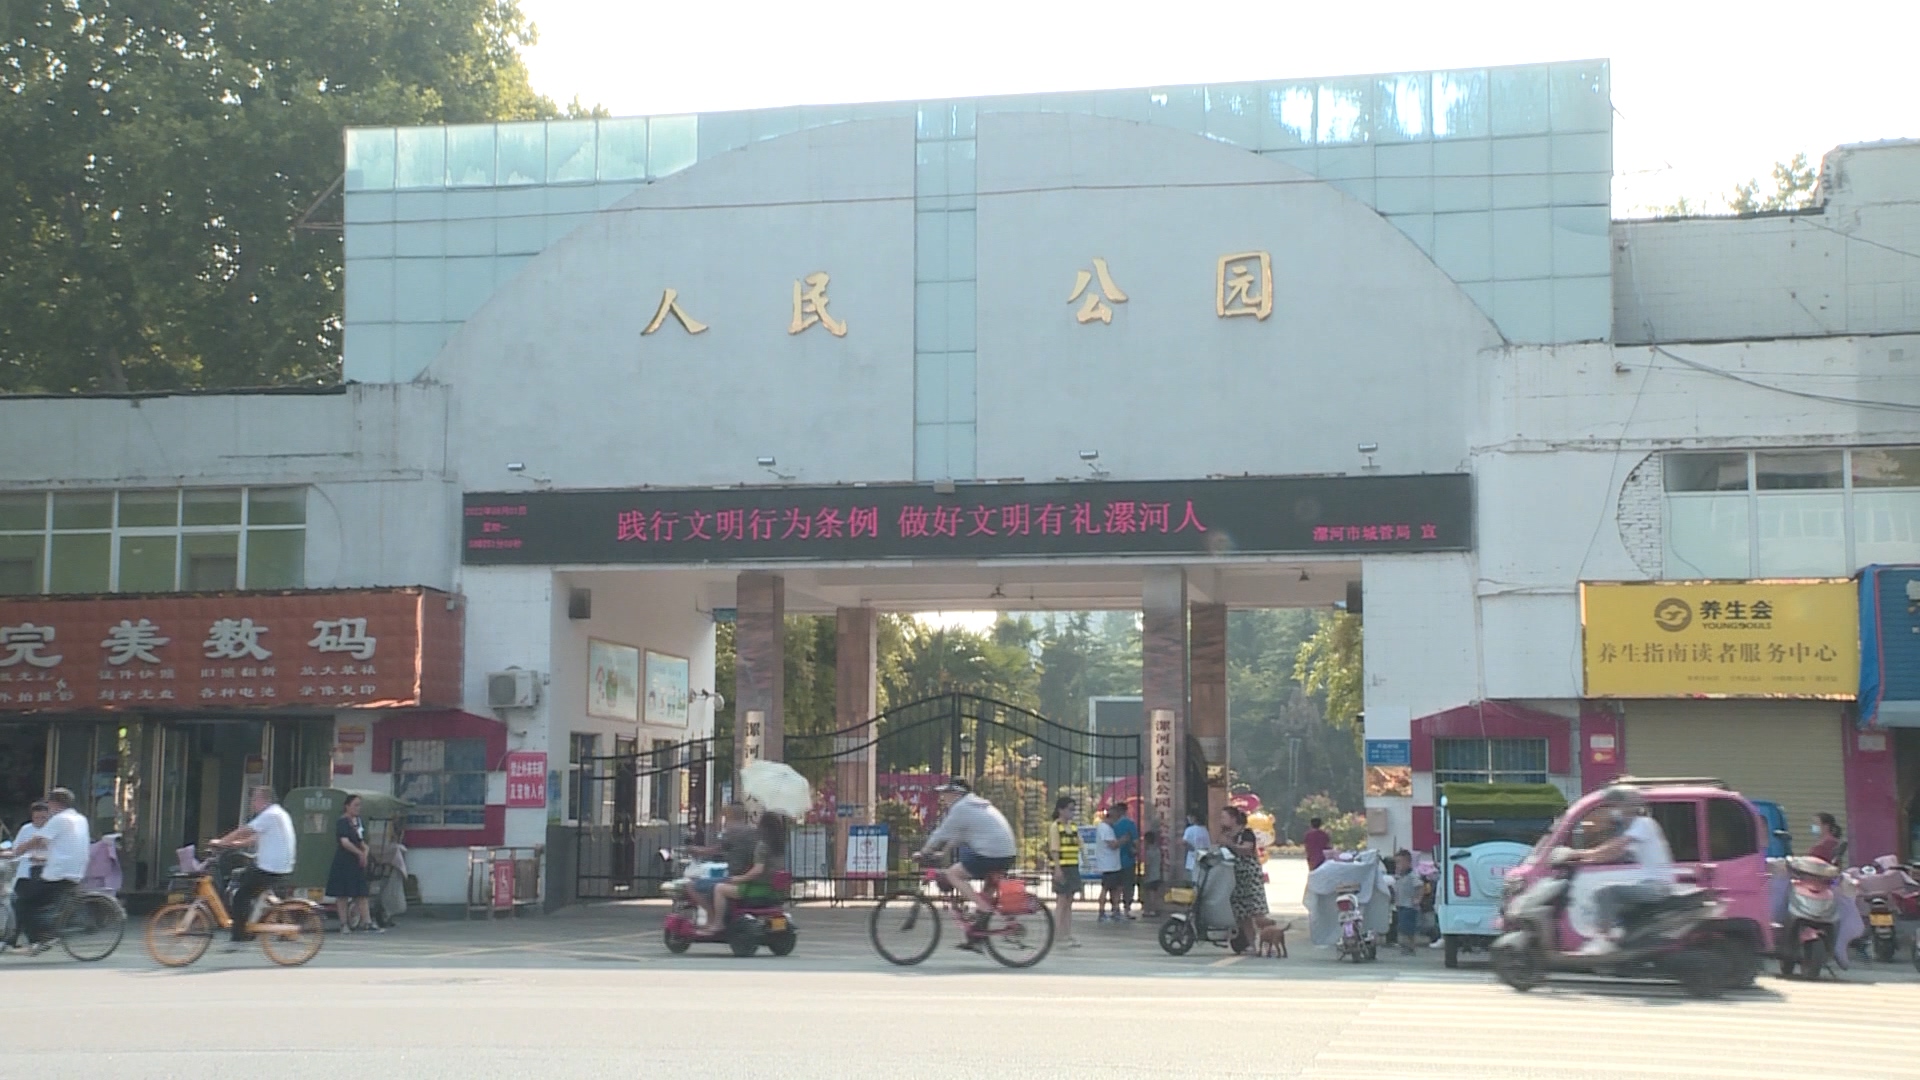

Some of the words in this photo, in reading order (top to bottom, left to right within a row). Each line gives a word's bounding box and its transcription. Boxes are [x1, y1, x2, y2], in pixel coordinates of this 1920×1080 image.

[641, 251, 1274, 337] 人民公园
[617, 505, 879, 542] 践行文明行为条例
[897, 499, 1208, 541] 做好文明有礼漯河人
[1312, 524, 1411, 542] 漯河市城管局
[1421, 523, 1437, 540] 宣
[1699, 600, 1773, 620] 养生会
[0, 617, 377, 669] 完美数码
[1598, 641, 1838, 664] 养生指南读者服务中心
